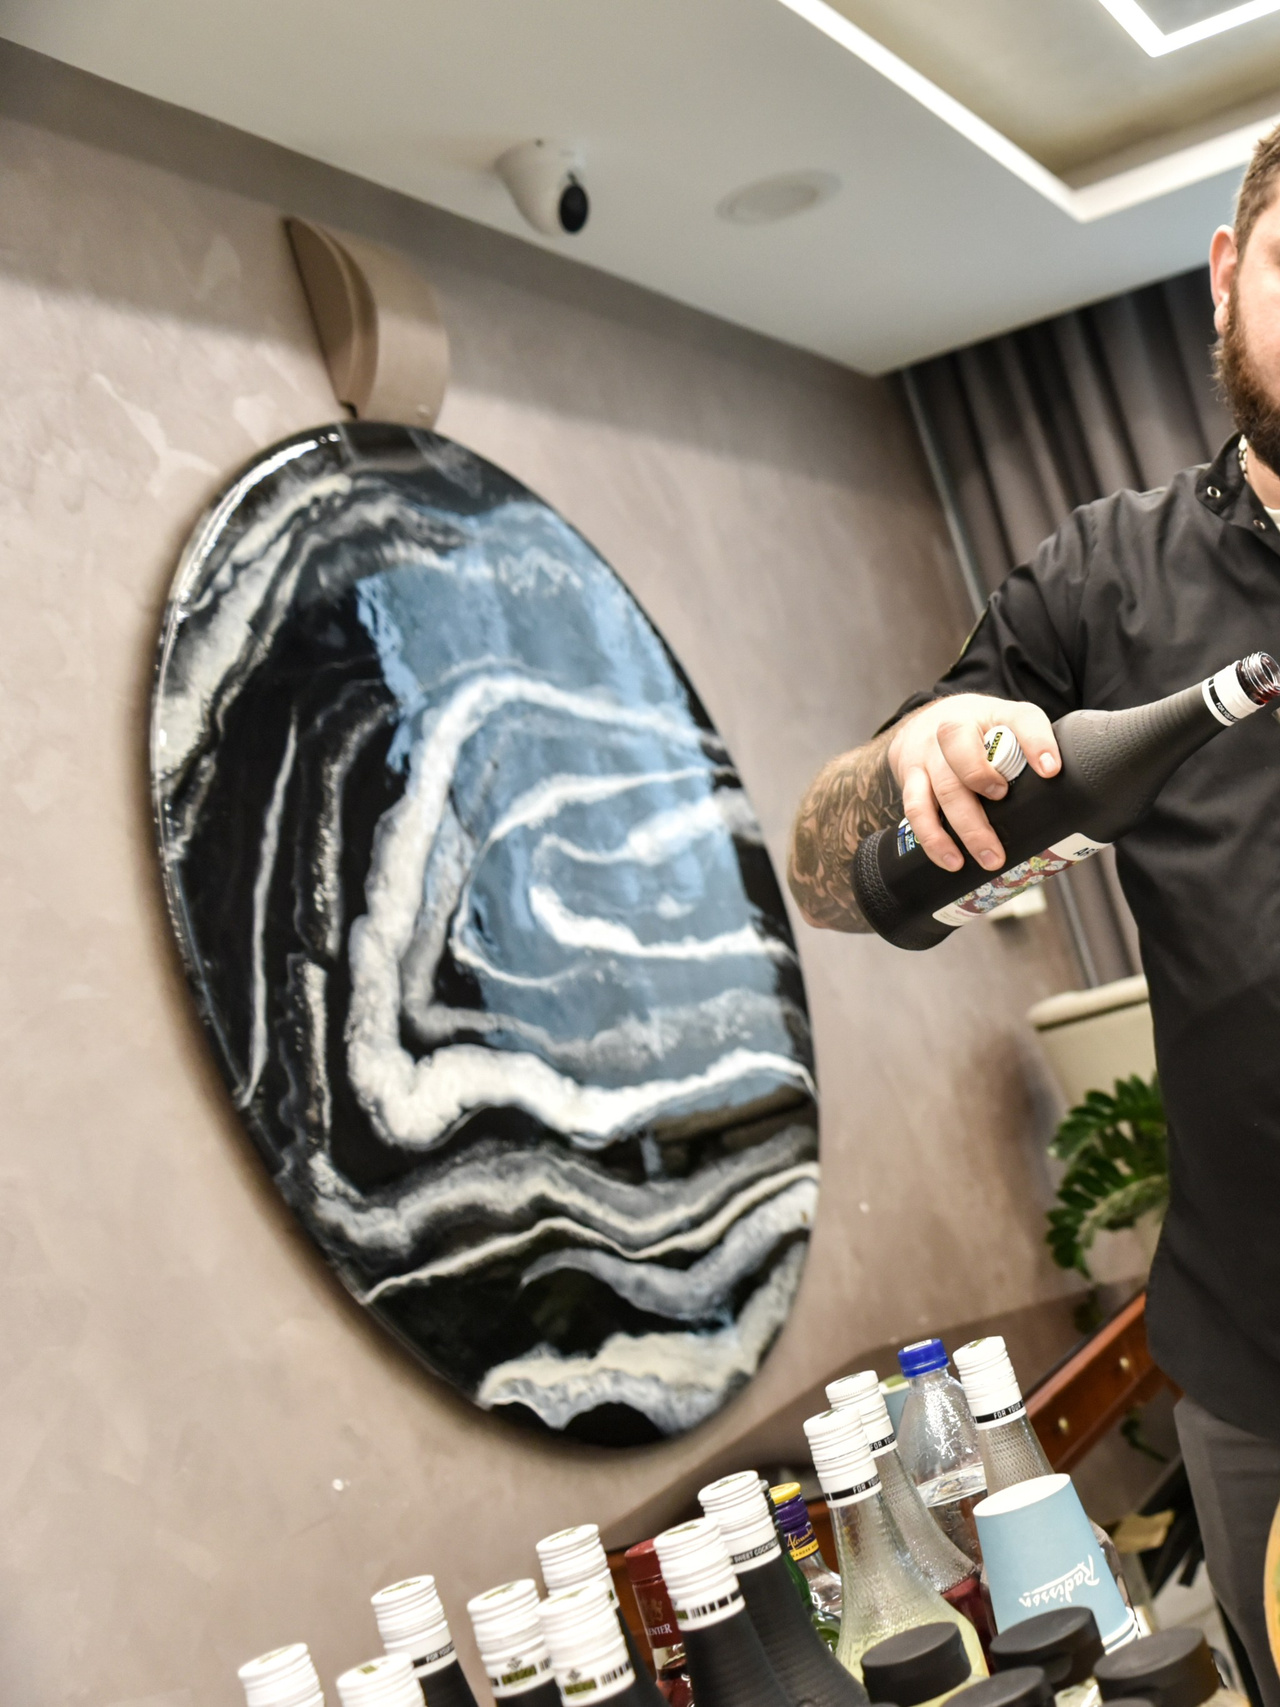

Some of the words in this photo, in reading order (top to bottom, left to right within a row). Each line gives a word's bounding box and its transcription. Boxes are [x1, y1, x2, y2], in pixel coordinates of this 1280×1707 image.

[993, 1409, 1007, 1420] FOR
[869, 1439, 883, 1451] FOR
[852, 1482, 867, 1495] FOR
[1018, 1553, 1100, 1608] Radisson
